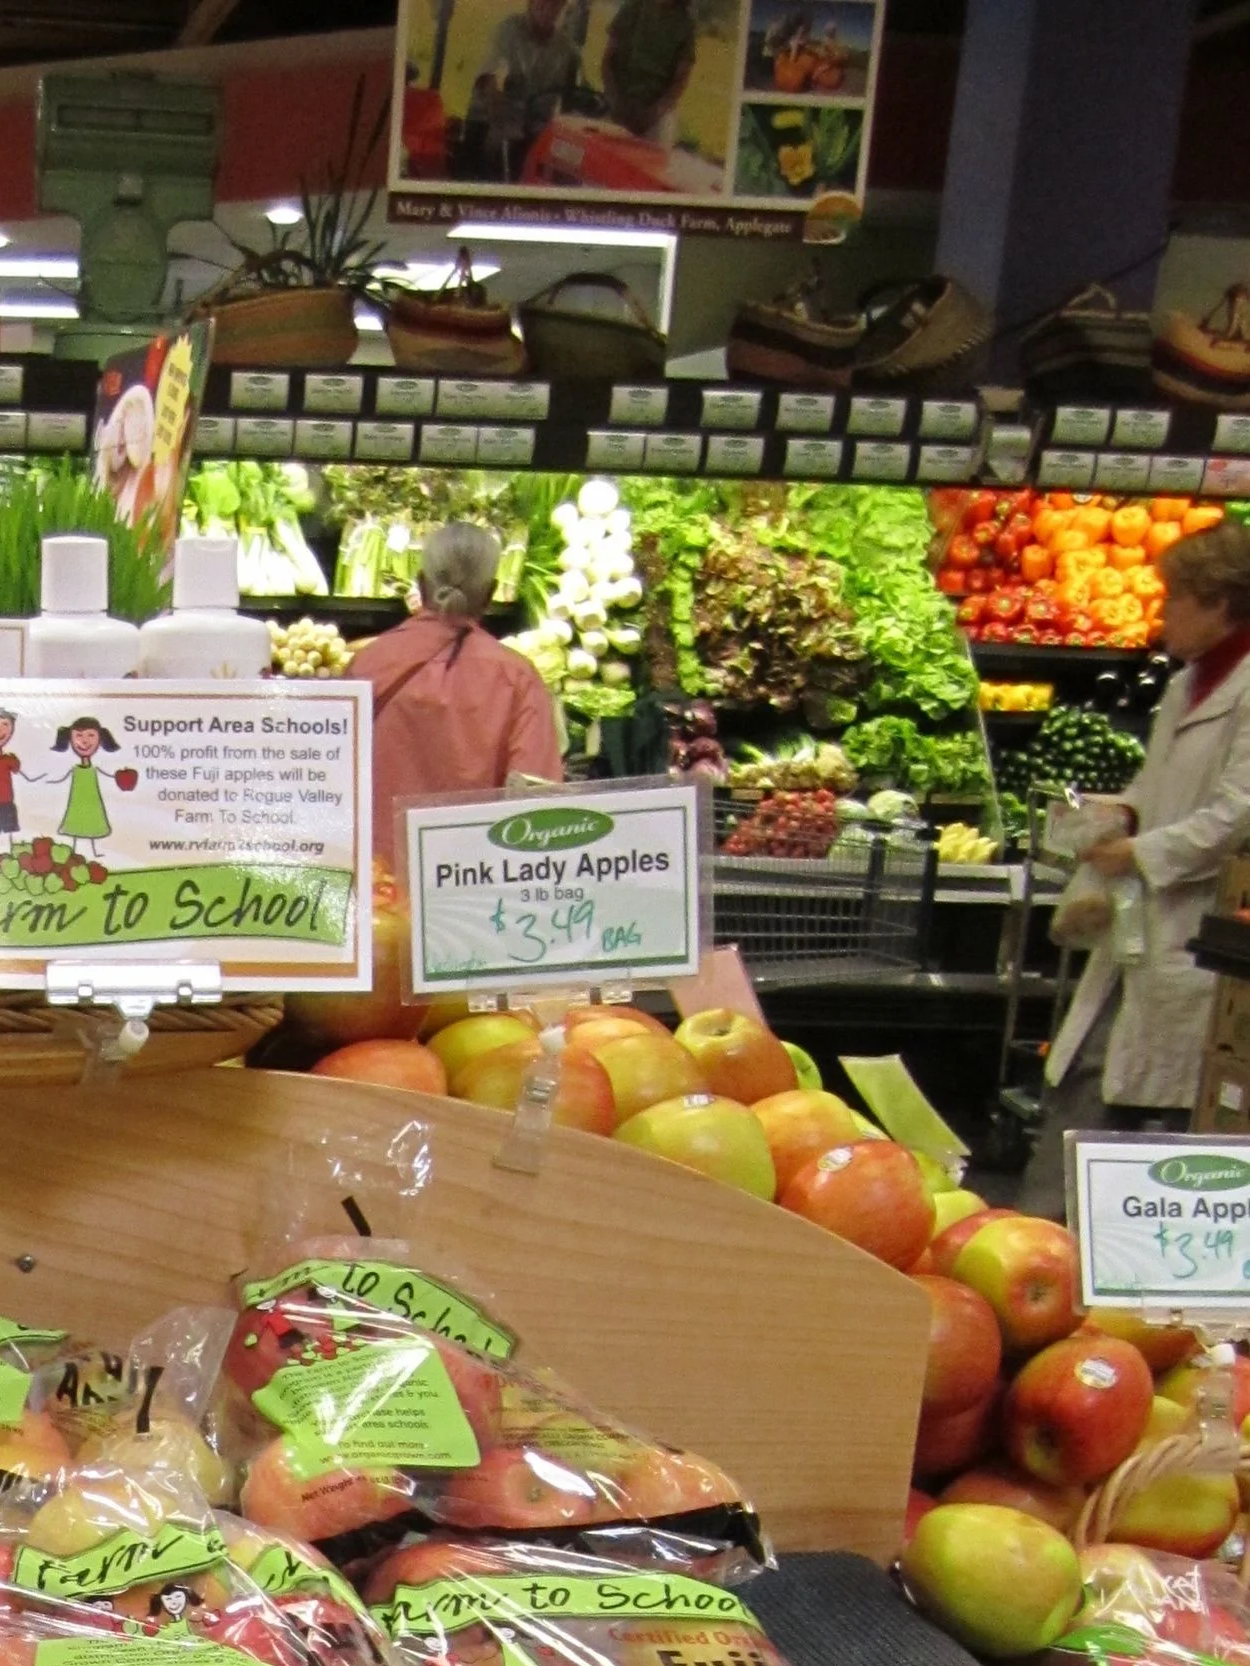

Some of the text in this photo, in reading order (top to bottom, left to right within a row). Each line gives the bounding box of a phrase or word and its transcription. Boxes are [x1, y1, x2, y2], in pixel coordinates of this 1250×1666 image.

[726, 215, 792, 239] Applegate
[123, 715, 348, 737] Support Area Schools!
[133, 744, 341, 762] 100% profit from the sale of
[145, 766, 327, 785] these Fuji apples will be
[157, 787, 343, 807] donated to Rogue Valley
[174, 808, 214, 825] Farm
[219, 809, 237, 825] To
[501, 816, 599, 850] Organic
[435, 849, 671, 888] Pink Lady Apples
[520, 885, 584, 902] 3 lb bag
[102, 882, 150, 936] to
[168, 876, 328, 933] School
[601, 920, 642, 953] BAG
[1160, 1160, 1242, 1188] Organic
[1122, 1195, 1183, 1219] Gala
[341, 1266, 380, 1296] to
[523, 1581, 572, 1611] to
[608, 1627, 711, 1648] Certified
